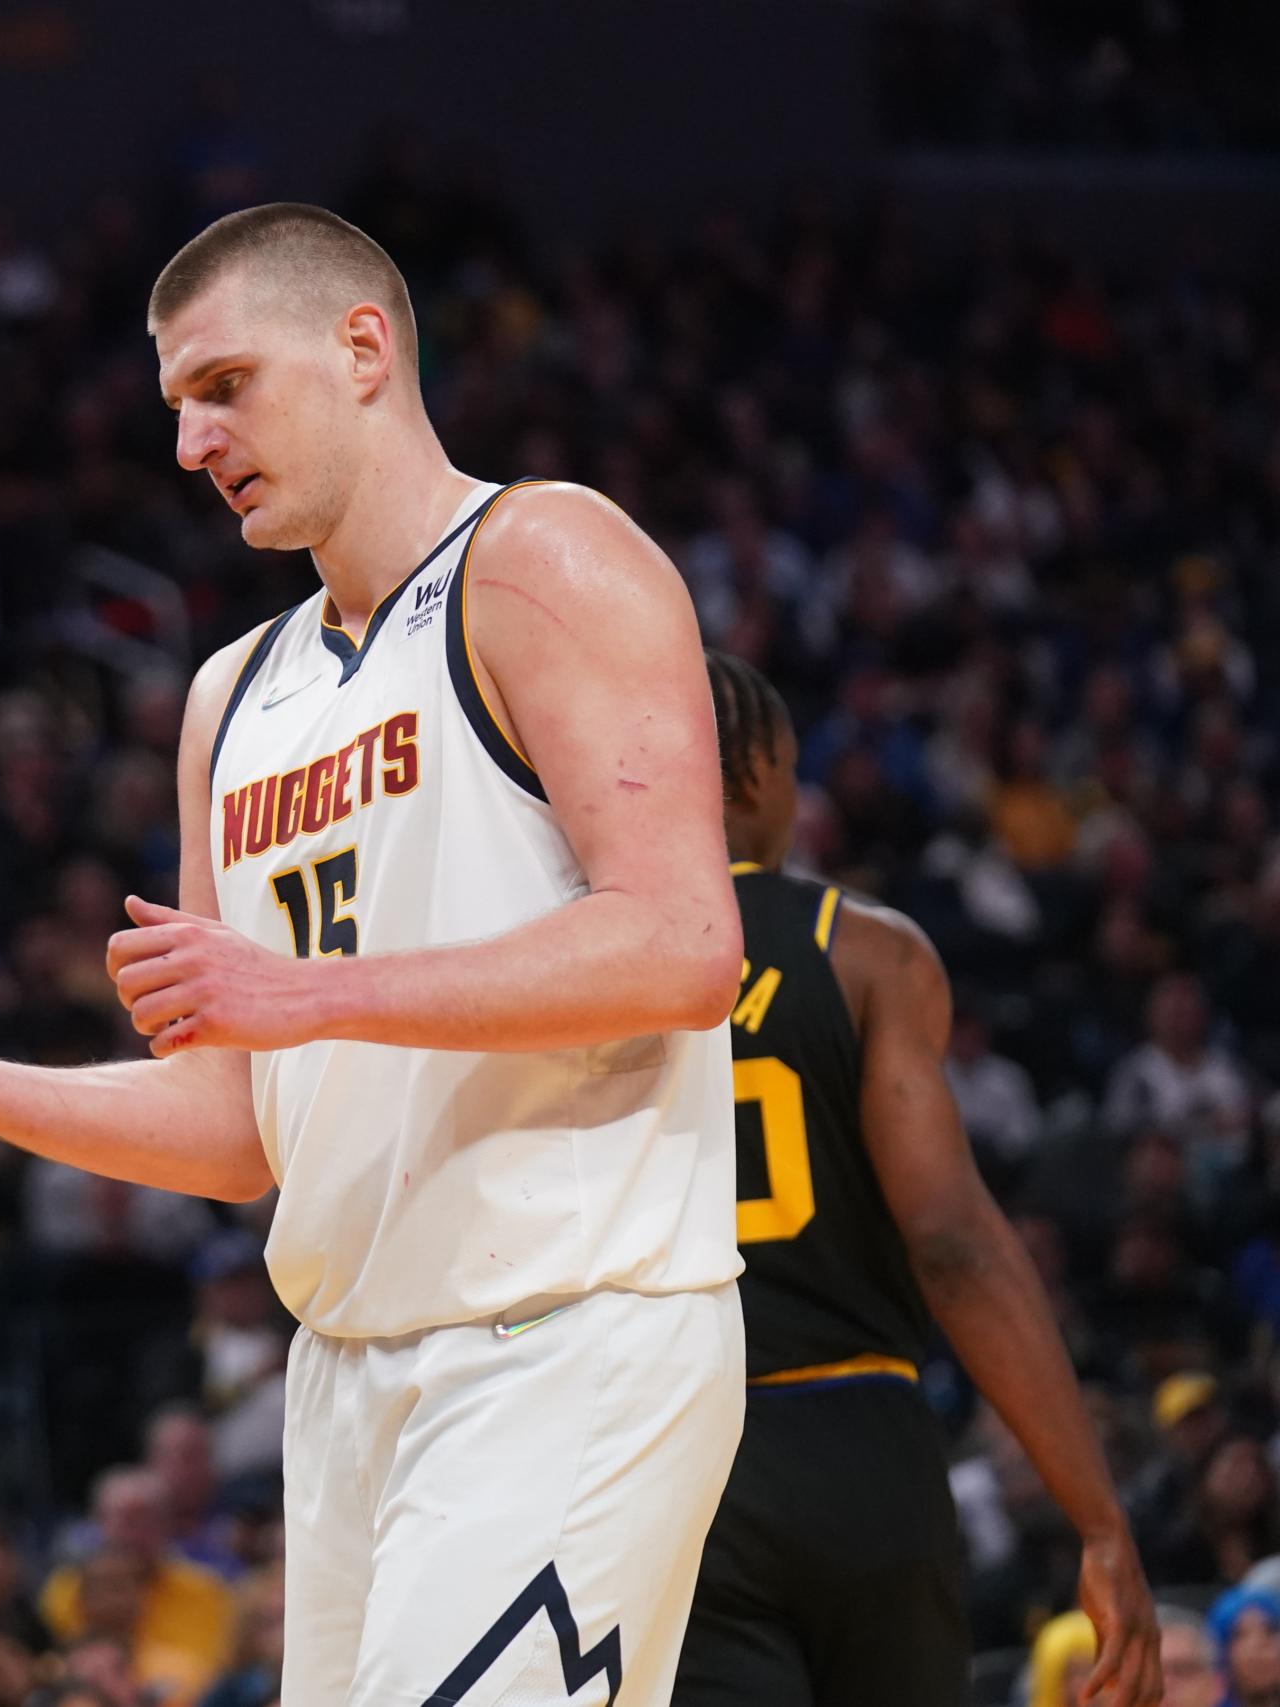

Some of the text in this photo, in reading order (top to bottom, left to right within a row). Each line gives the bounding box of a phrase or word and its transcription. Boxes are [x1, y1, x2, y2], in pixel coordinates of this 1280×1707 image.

[407, 601, 442, 627] Western
[415, 568, 452, 610] WU
[408, 617, 432, 636] Union
[222, 711, 419, 872] NUGGETS
[268, 843, 359, 959] 15
[730, 957, 782, 1034] A
